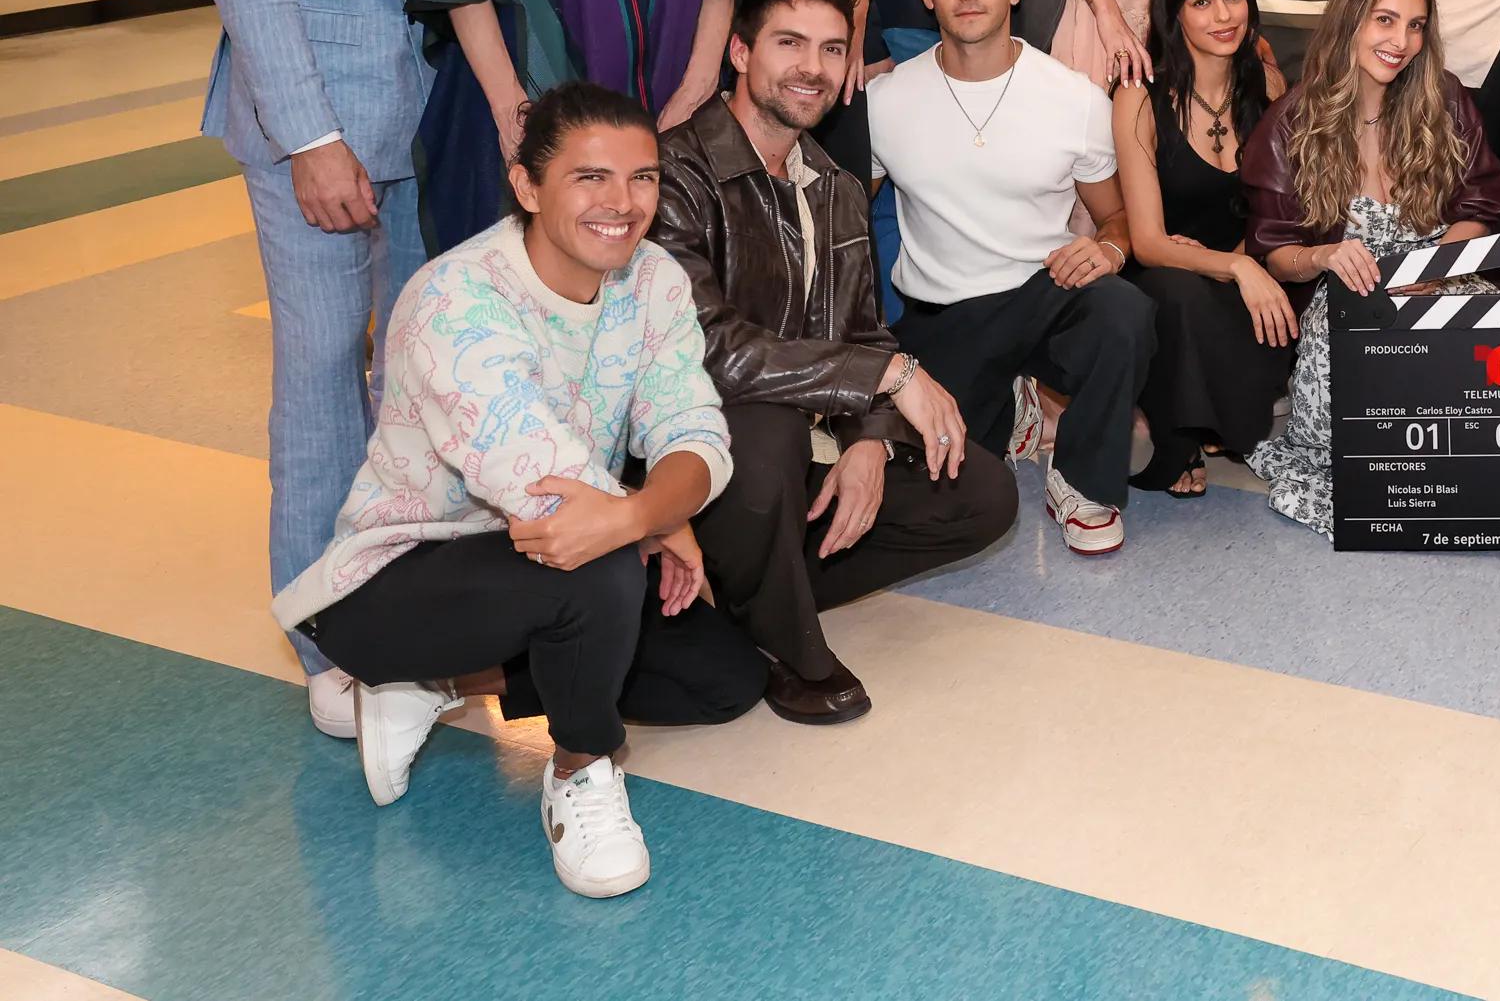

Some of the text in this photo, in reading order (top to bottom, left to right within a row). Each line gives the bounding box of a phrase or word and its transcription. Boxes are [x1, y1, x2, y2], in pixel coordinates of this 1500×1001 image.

[1365, 344, 1428, 354] PRODUCCIÓN
[1446, 407, 1462, 415] Eloy
[1465, 406, 1492, 414] Castro
[1406, 423, 1438, 450] 01
[1369, 463, 1426, 471] DIRECTORES
[1388, 485, 1457, 494] Nicolas Di Blasi
[1388, 499, 1436, 507] Luis Sierra
[1371, 523, 1403, 532] FECHA
[1423, 534, 1429, 544] 7
[1434, 533, 1448, 544] de
